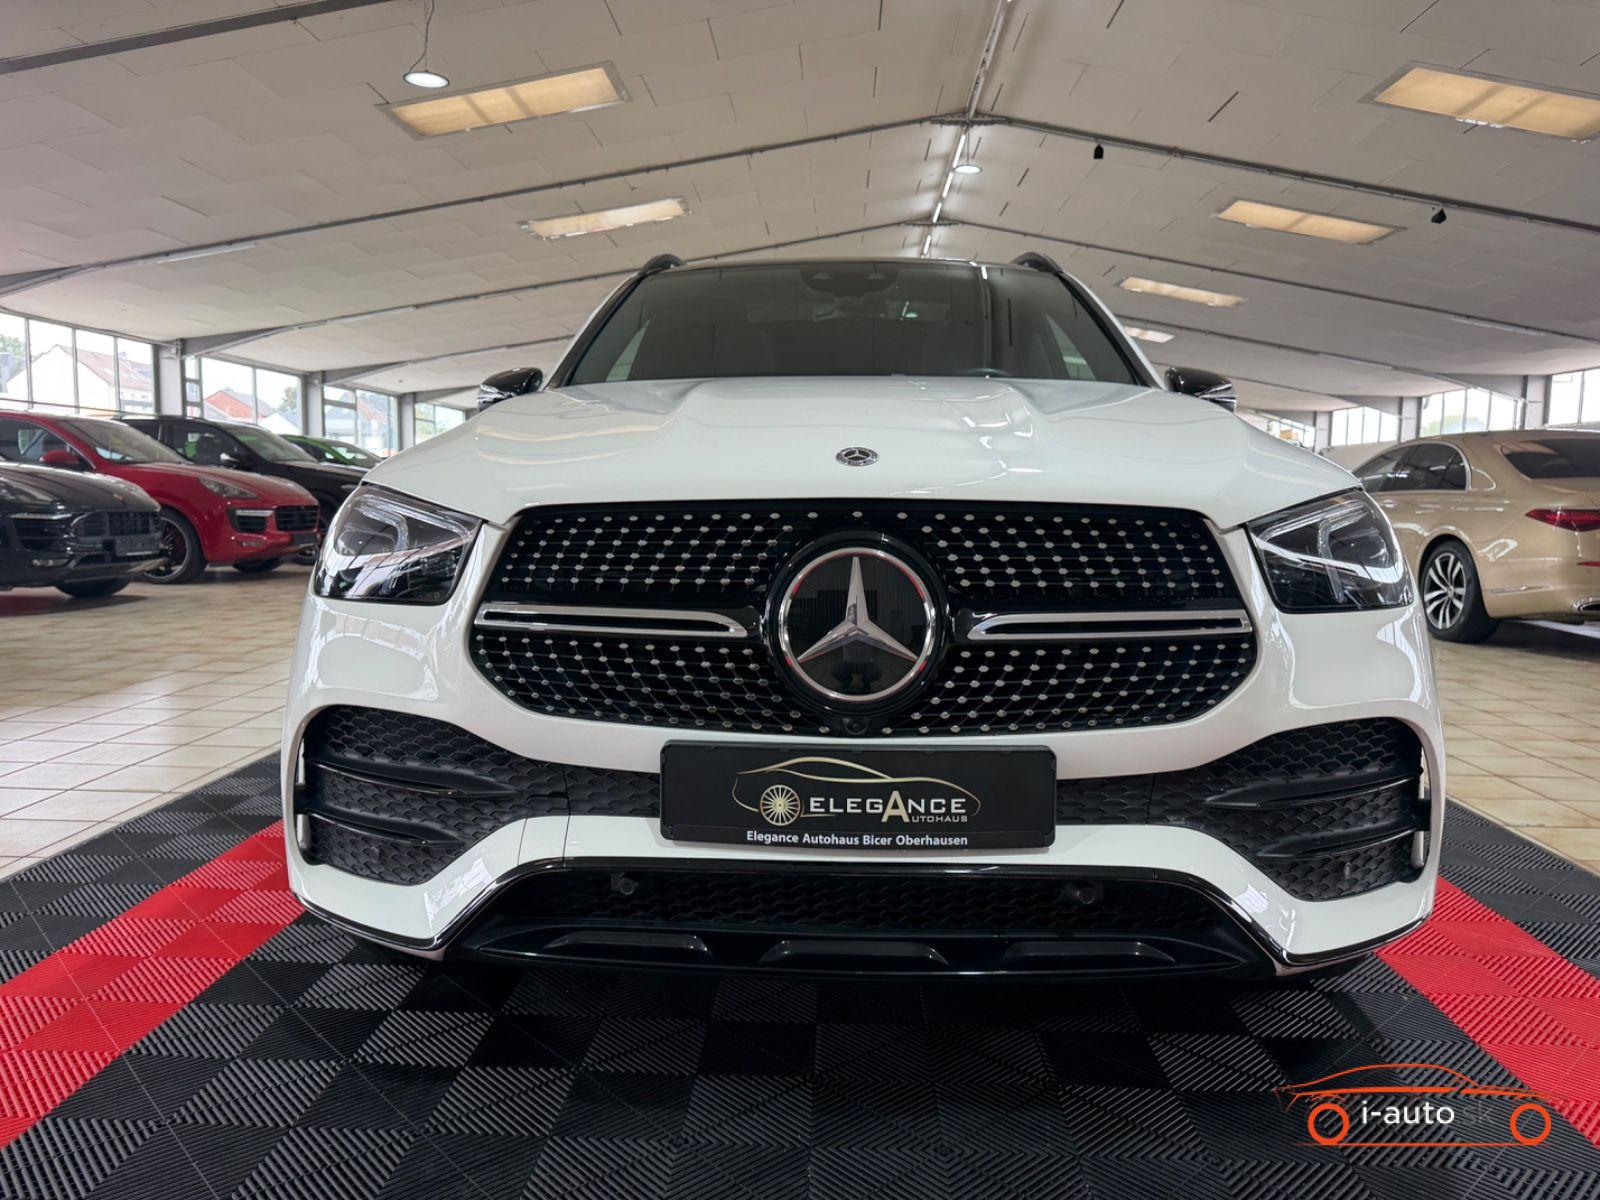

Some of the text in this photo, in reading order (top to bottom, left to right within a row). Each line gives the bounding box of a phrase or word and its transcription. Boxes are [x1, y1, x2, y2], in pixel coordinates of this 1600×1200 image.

[809, 791, 966, 822] ELEGANCE
[746, 830, 968, 847] Elegance Autohaus Bicer Oberhausen
